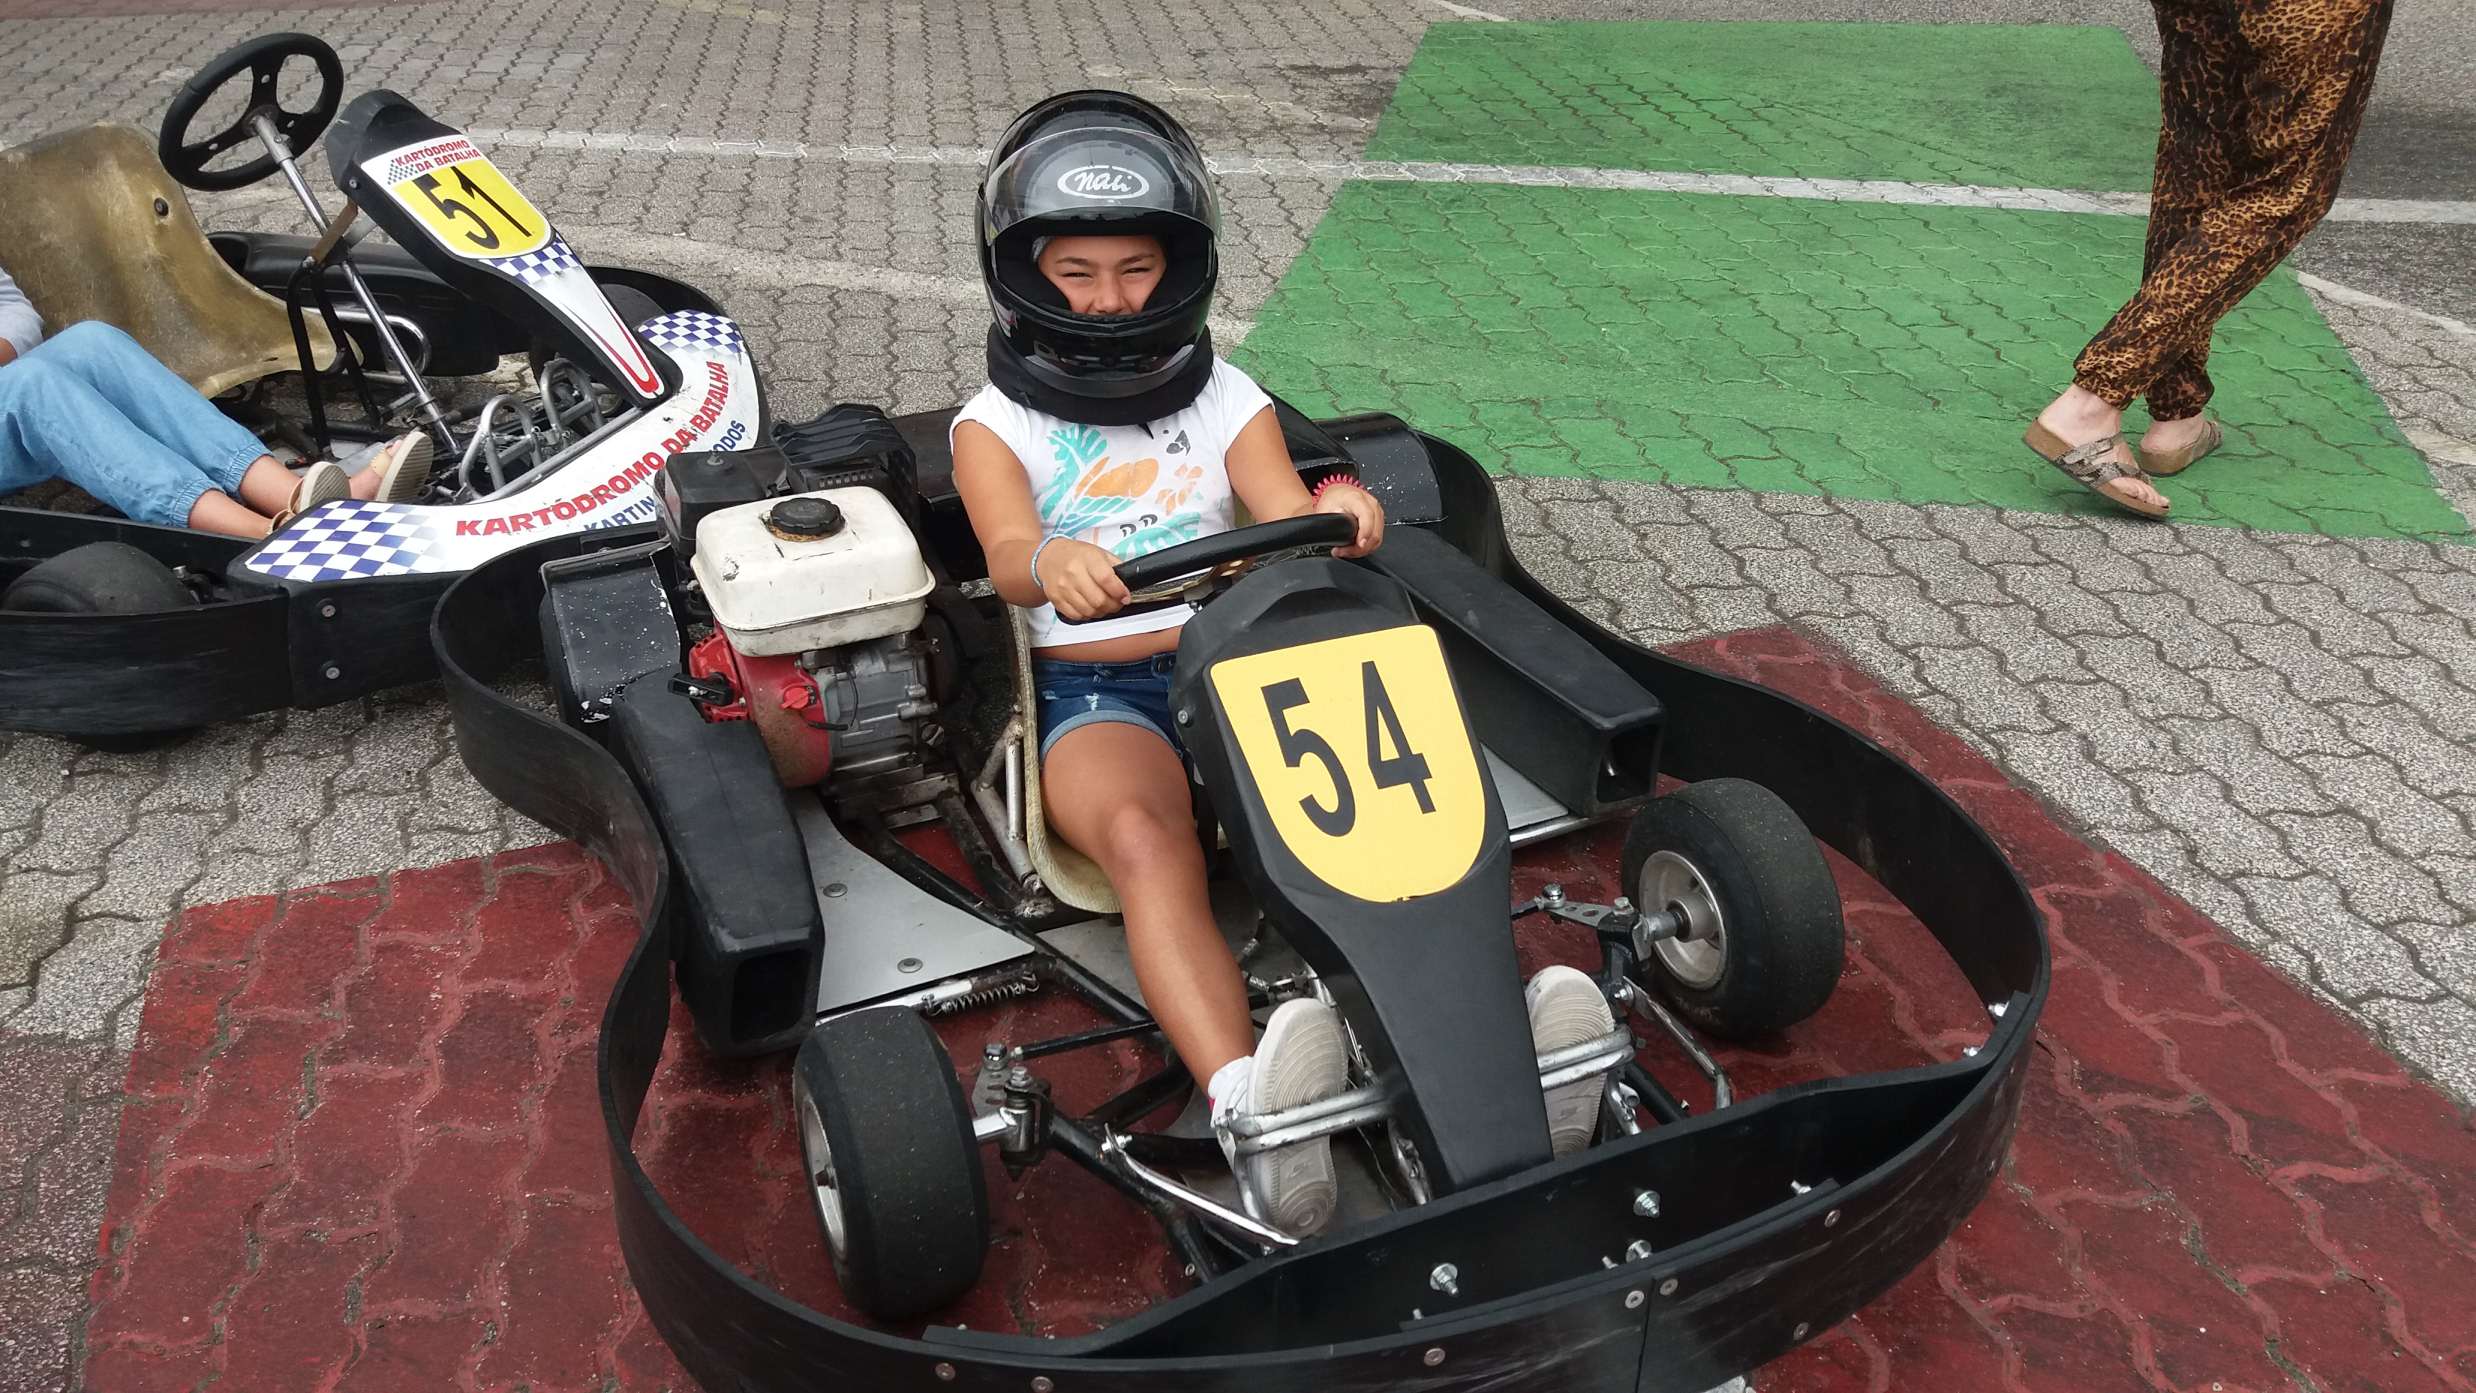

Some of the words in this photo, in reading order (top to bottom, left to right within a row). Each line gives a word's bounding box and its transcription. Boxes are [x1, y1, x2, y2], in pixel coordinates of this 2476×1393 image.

[395, 140, 470, 166] KARTÓDROMO
[415, 160, 434, 172] DA
[434, 149, 480, 166] BATALHA
[412, 165, 532, 249] 51
[455, 452, 665, 536] KARTÓDROMO
[661, 428, 698, 454] DA
[689, 361, 729, 432] BATALHA
[1260, 660, 1437, 838] 54
